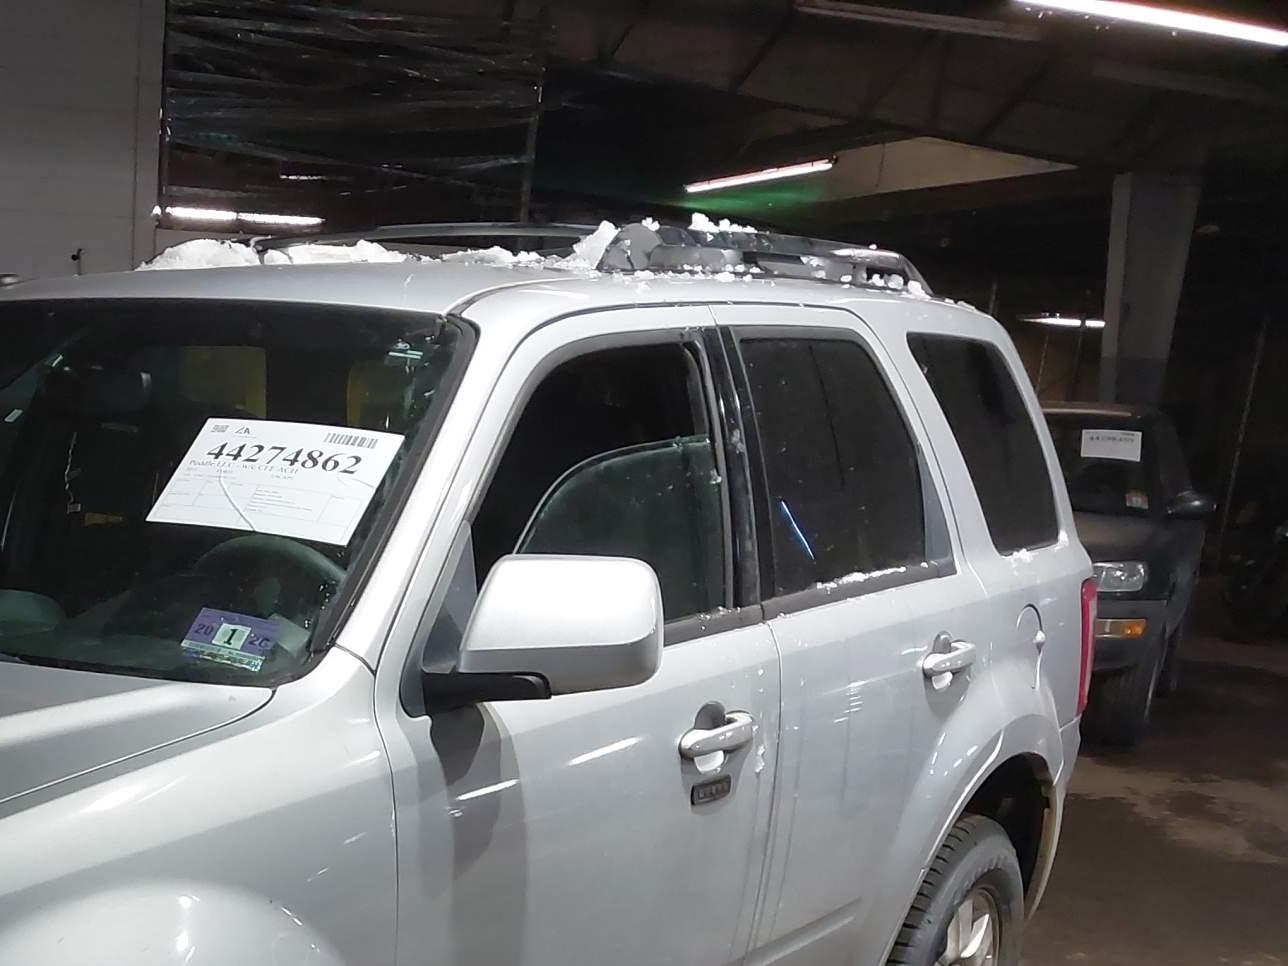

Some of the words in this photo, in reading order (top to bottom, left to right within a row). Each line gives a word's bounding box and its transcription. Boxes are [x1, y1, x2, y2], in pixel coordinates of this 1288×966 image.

[206, 441, 362, 474] 44274862
[194, 623, 214, 635] 20
[223, 628, 239, 645] 1
